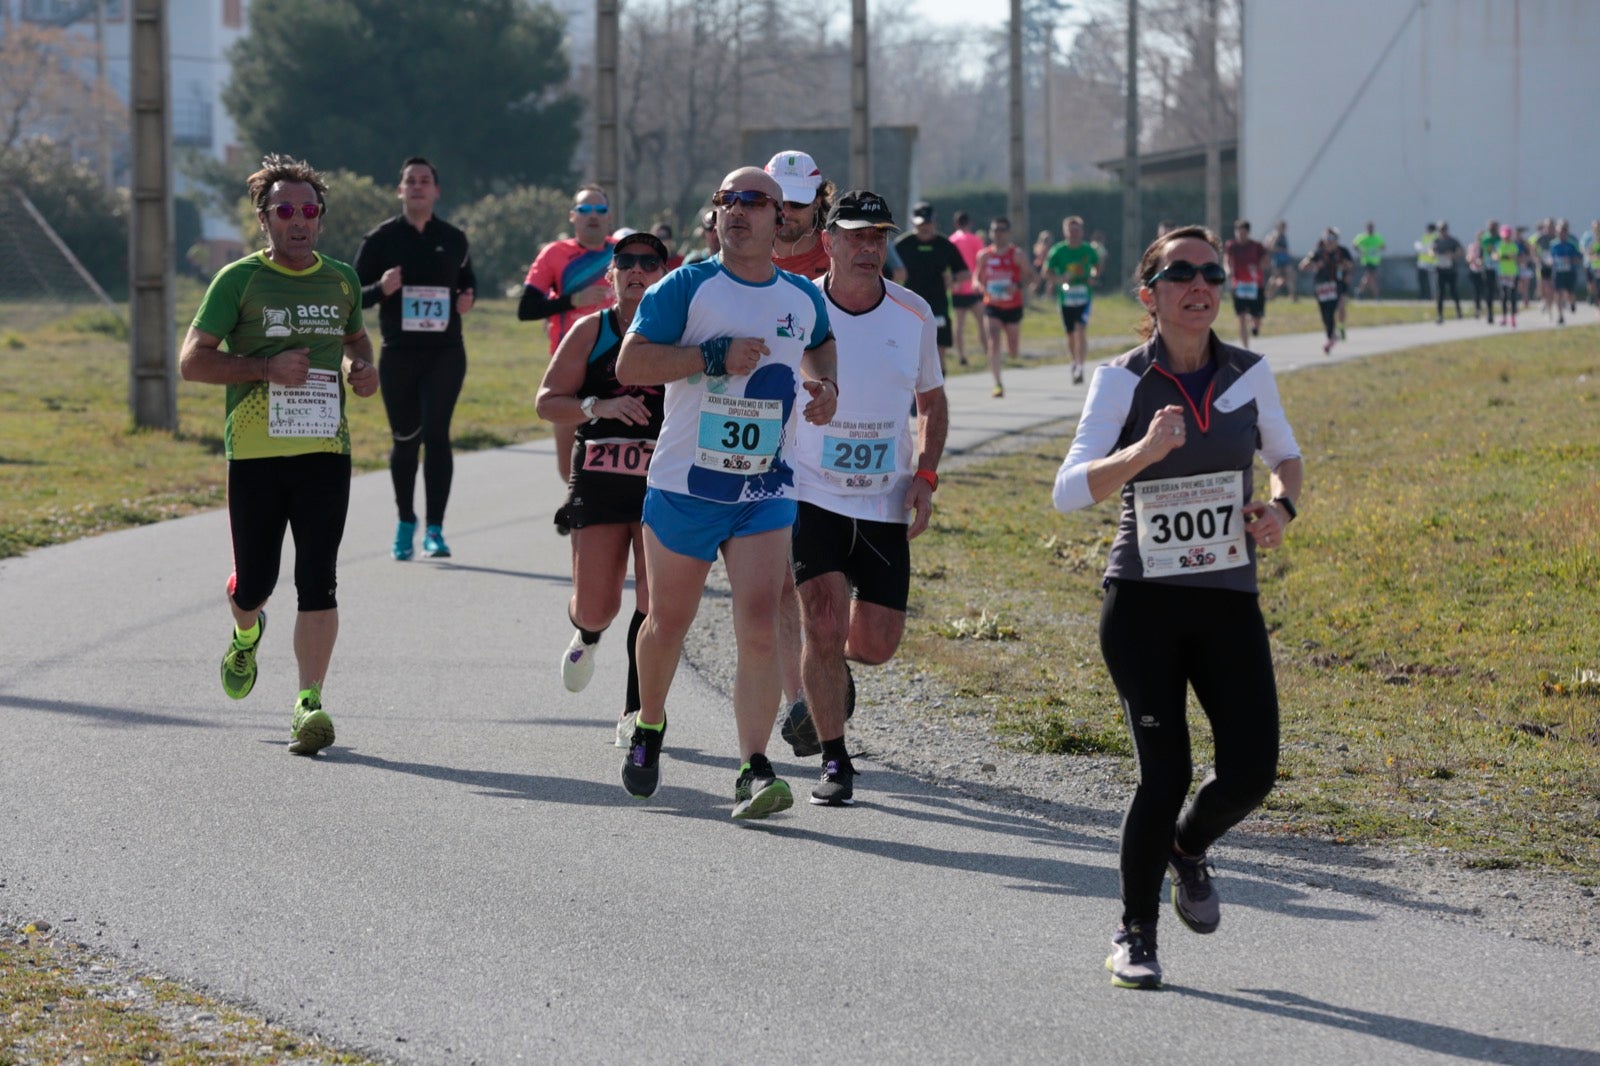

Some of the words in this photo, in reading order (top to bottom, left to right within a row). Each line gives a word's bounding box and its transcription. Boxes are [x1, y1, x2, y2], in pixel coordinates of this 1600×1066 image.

[296, 304, 340, 319] aecc
[411, 300, 443, 317] 173
[312, 391, 338, 399] CONTRA
[284, 407, 312, 415] aecc
[723, 398, 737, 406] GRAN
[738, 400, 757, 408] PREMIO
[758, 401, 764, 409] DE
[843, 421, 857, 429] GRAN
[858, 422, 876, 430] PREMIO
[877, 422, 882, 430] DE
[721, 421, 760, 451] 30
[589, 444, 654, 472] 2107
[834, 442, 888, 470] 297
[1160, 482, 1179, 492] GRAN
[1180, 479, 1205, 490] PREMIO
[1206, 478, 1214, 487] DE
[1150, 505, 1233, 544] 3007
